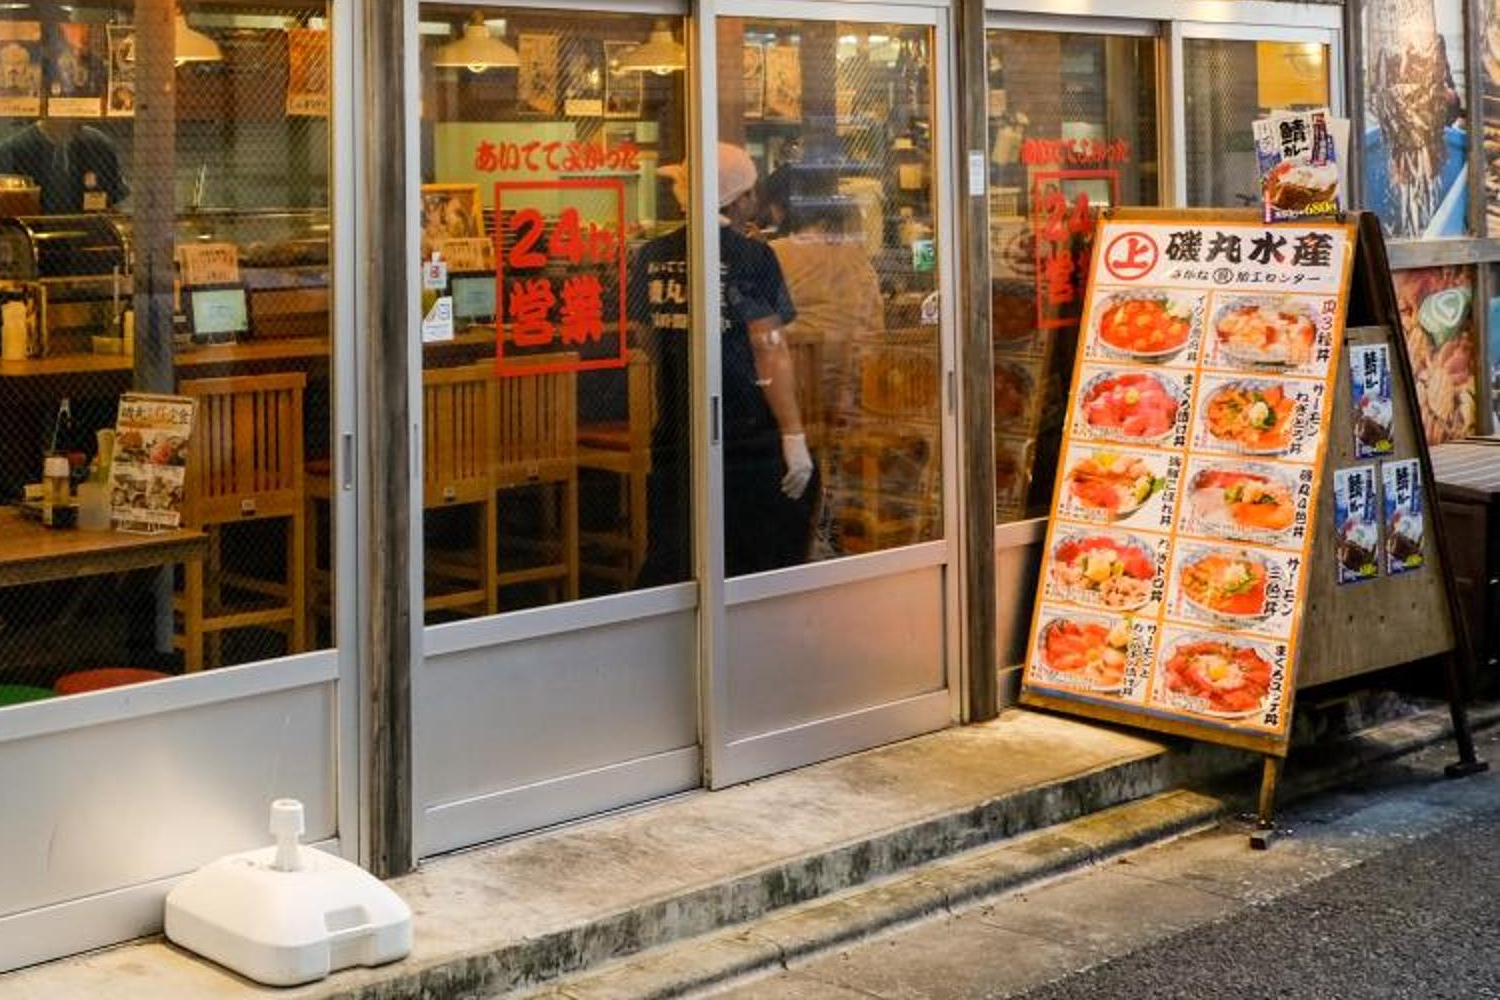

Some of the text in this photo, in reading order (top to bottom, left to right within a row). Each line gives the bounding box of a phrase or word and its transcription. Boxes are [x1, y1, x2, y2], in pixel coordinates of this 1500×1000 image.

[475, 139, 641, 172] あいててよかった
[1165, 229, 1333, 267] 磯丸水産
[509, 273, 604, 347] 営業
